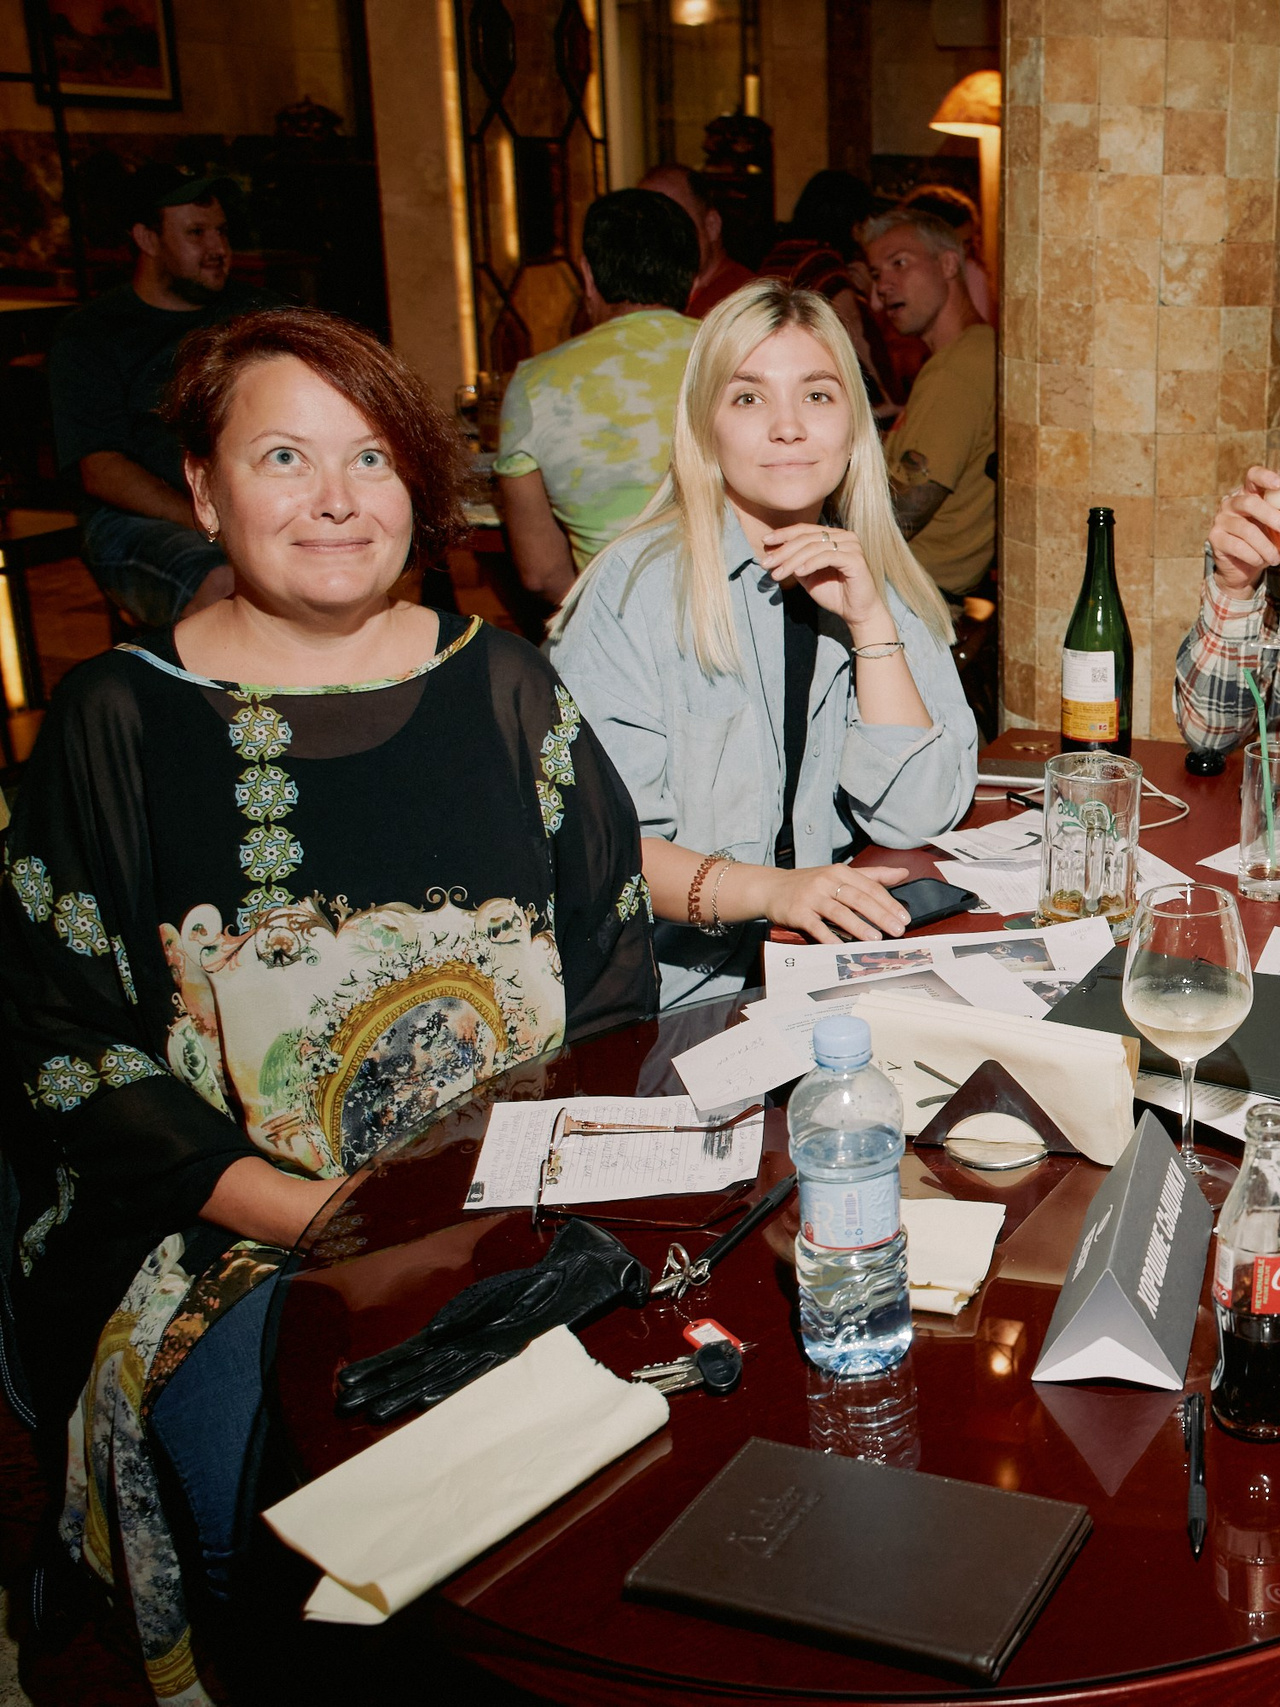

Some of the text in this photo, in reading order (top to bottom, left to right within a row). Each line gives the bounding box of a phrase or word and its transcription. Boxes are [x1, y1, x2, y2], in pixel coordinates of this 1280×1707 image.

[1137, 1156, 1187, 1320] ХОРОШИЕ СЫЩИКИ
[1255, 1259, 1265, 1309] RETURNABLE
